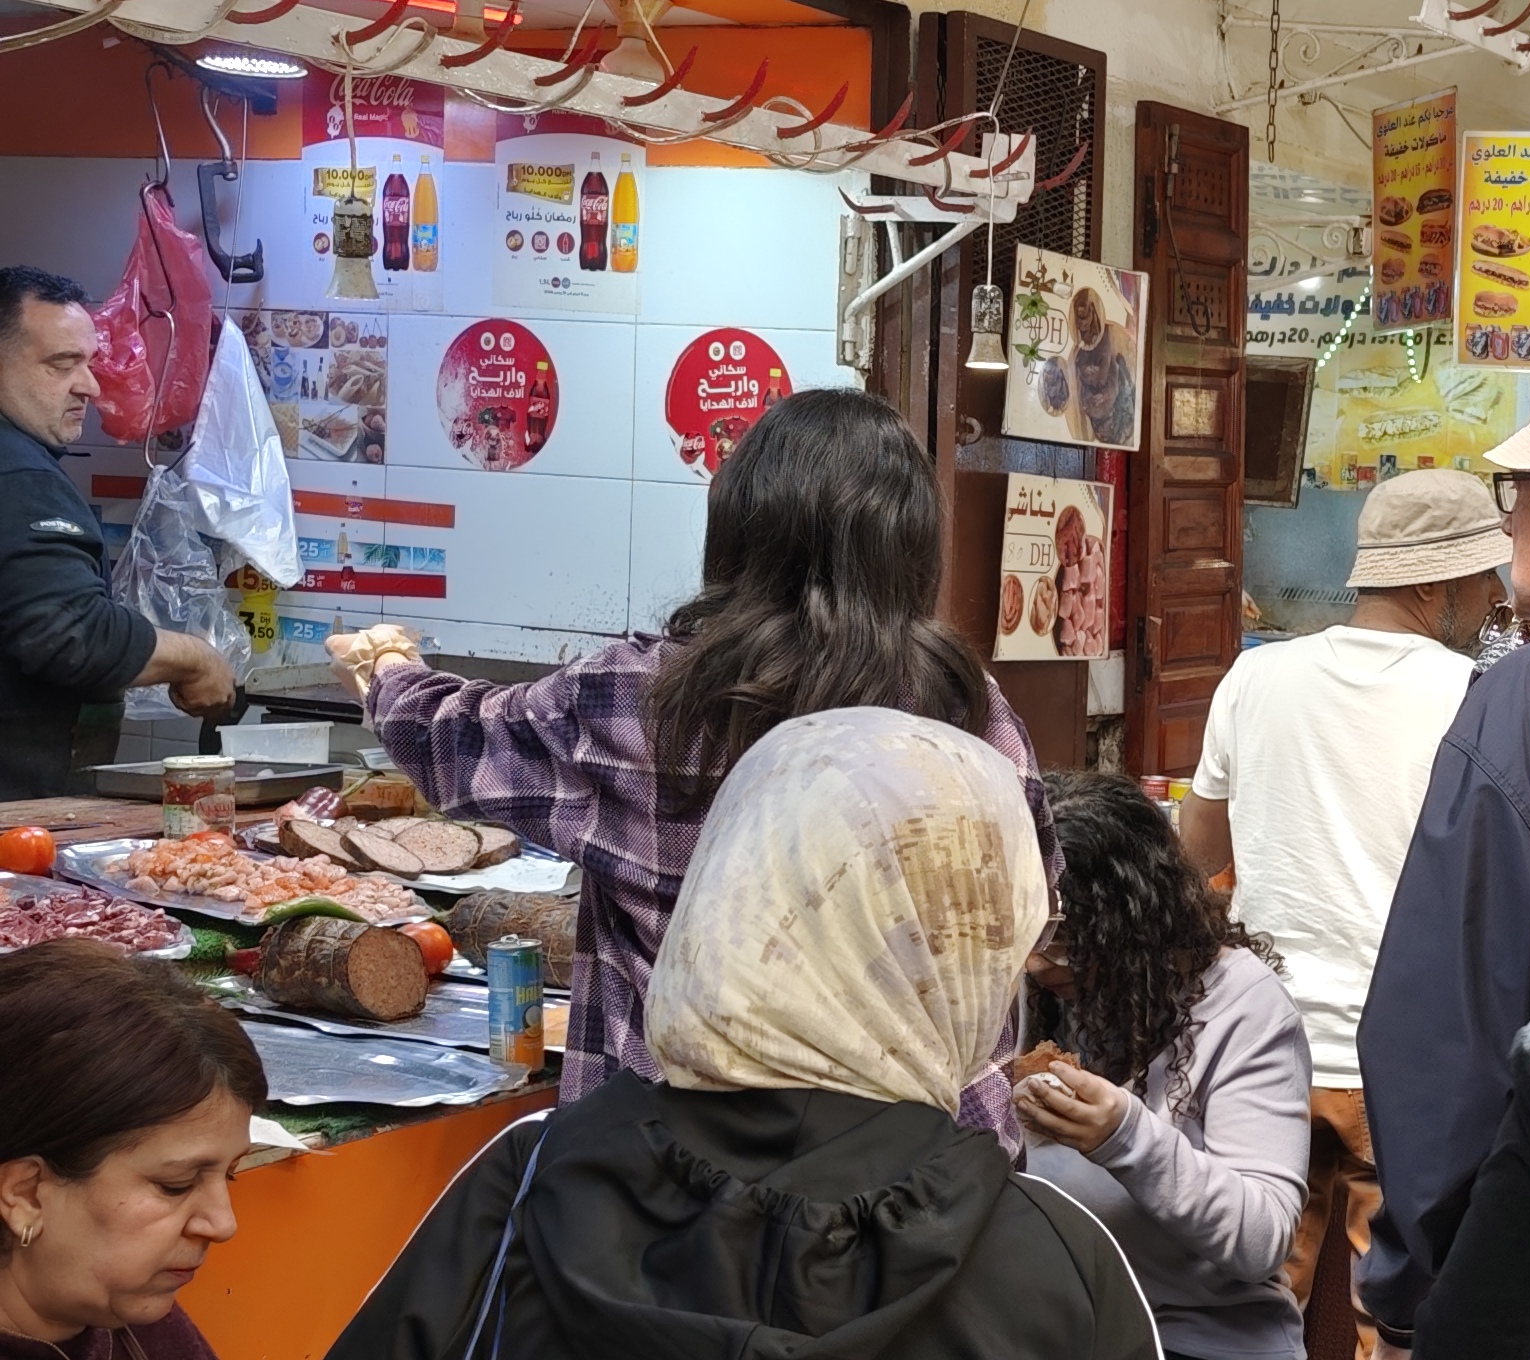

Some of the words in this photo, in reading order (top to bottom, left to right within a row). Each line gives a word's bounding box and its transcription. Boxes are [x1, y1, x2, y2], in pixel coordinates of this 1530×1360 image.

[1471, 144, 1517, 166] العلوي
[1483, 170, 1528, 189] خفيفة
[1468, 198, 1491, 217] درهم
[1492, 197, 1504, 212] 20
[479, 354, 516, 370] سكاني
[468, 366, 526, 387] واربح
[707, 364, 747, 381] سكاني
[697, 376, 759, 398] واربح
[699, 397, 735, 412] الهدايا
[299, 541, 319, 558] 25
[1029, 542, 1053, 567] DH
[292, 622, 314, 640] 25
